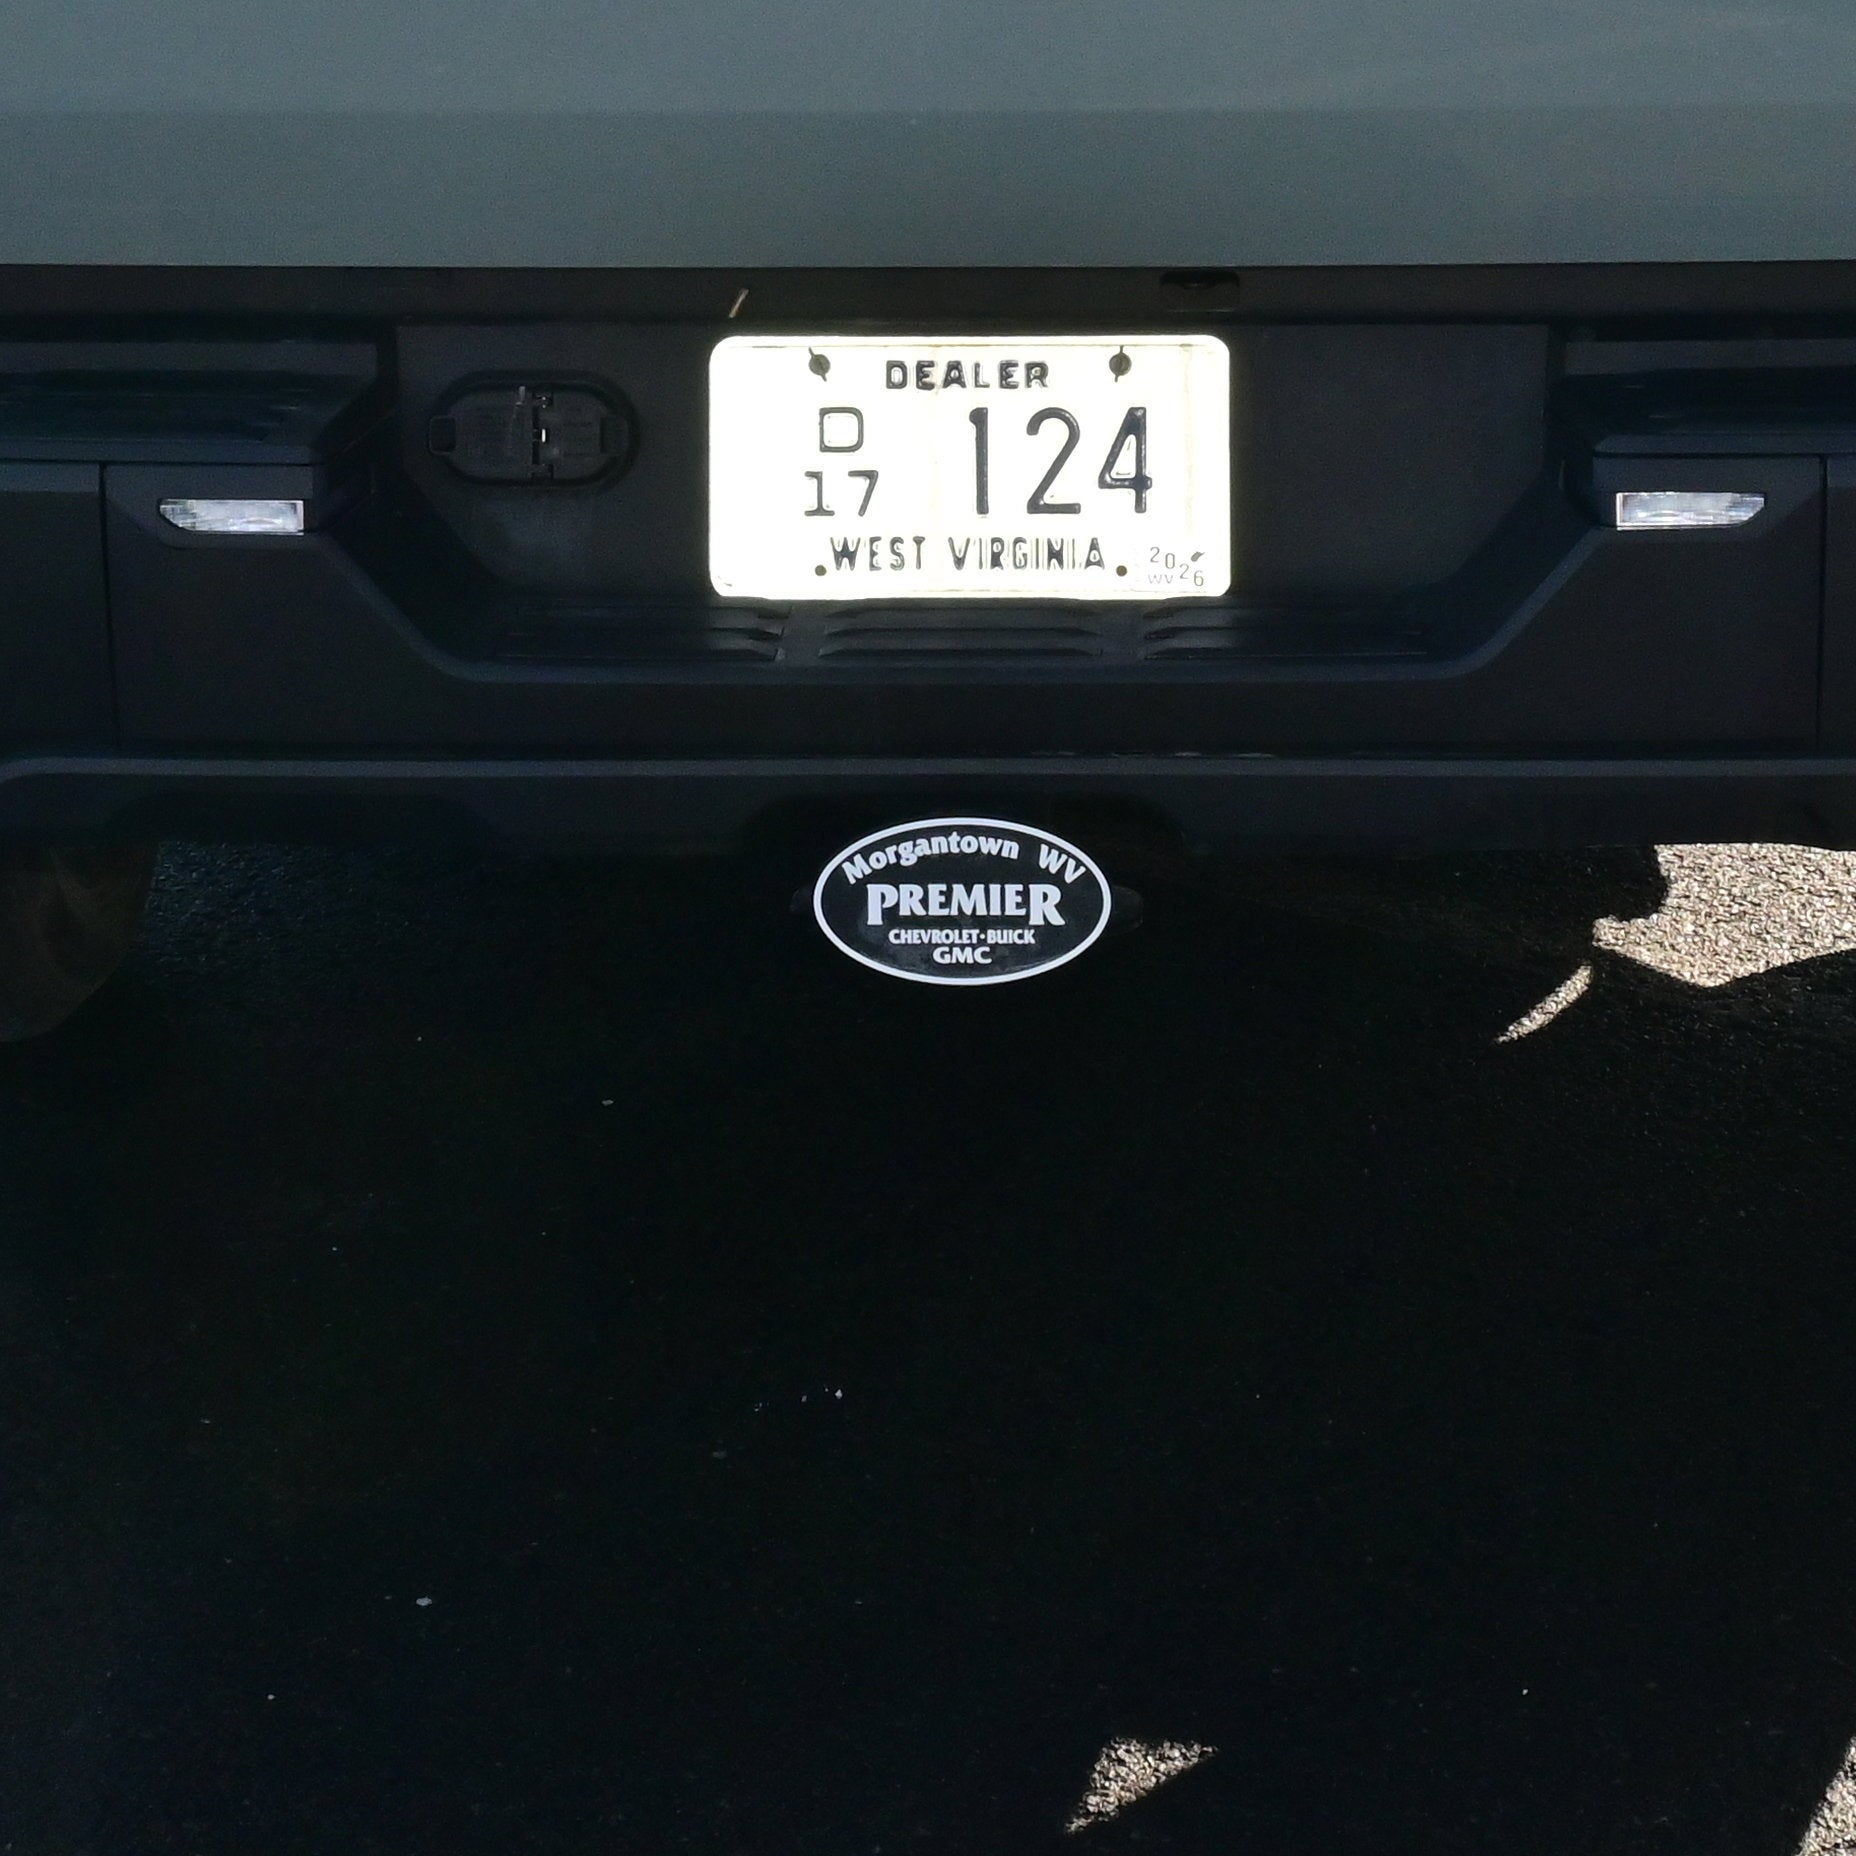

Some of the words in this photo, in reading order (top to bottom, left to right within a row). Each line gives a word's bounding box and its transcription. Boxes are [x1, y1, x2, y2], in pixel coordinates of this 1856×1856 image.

[885, 359, 1050, 391] DEALER
[818, 406, 865, 453] D
[968, 406, 1153, 515] 124
[803, 469, 880, 517] 17
[829, 535, 926, 571] WEST
[947, 535, 1106, 571] VIRGINIA
[1147, 573, 1174, 585] WV
[841, 830, 1020, 885] Morgantown
[1038, 843, 1087, 885] WV
[865, 882, 1066, 926] PREMIER
[932, 946, 993, 965] GMC
